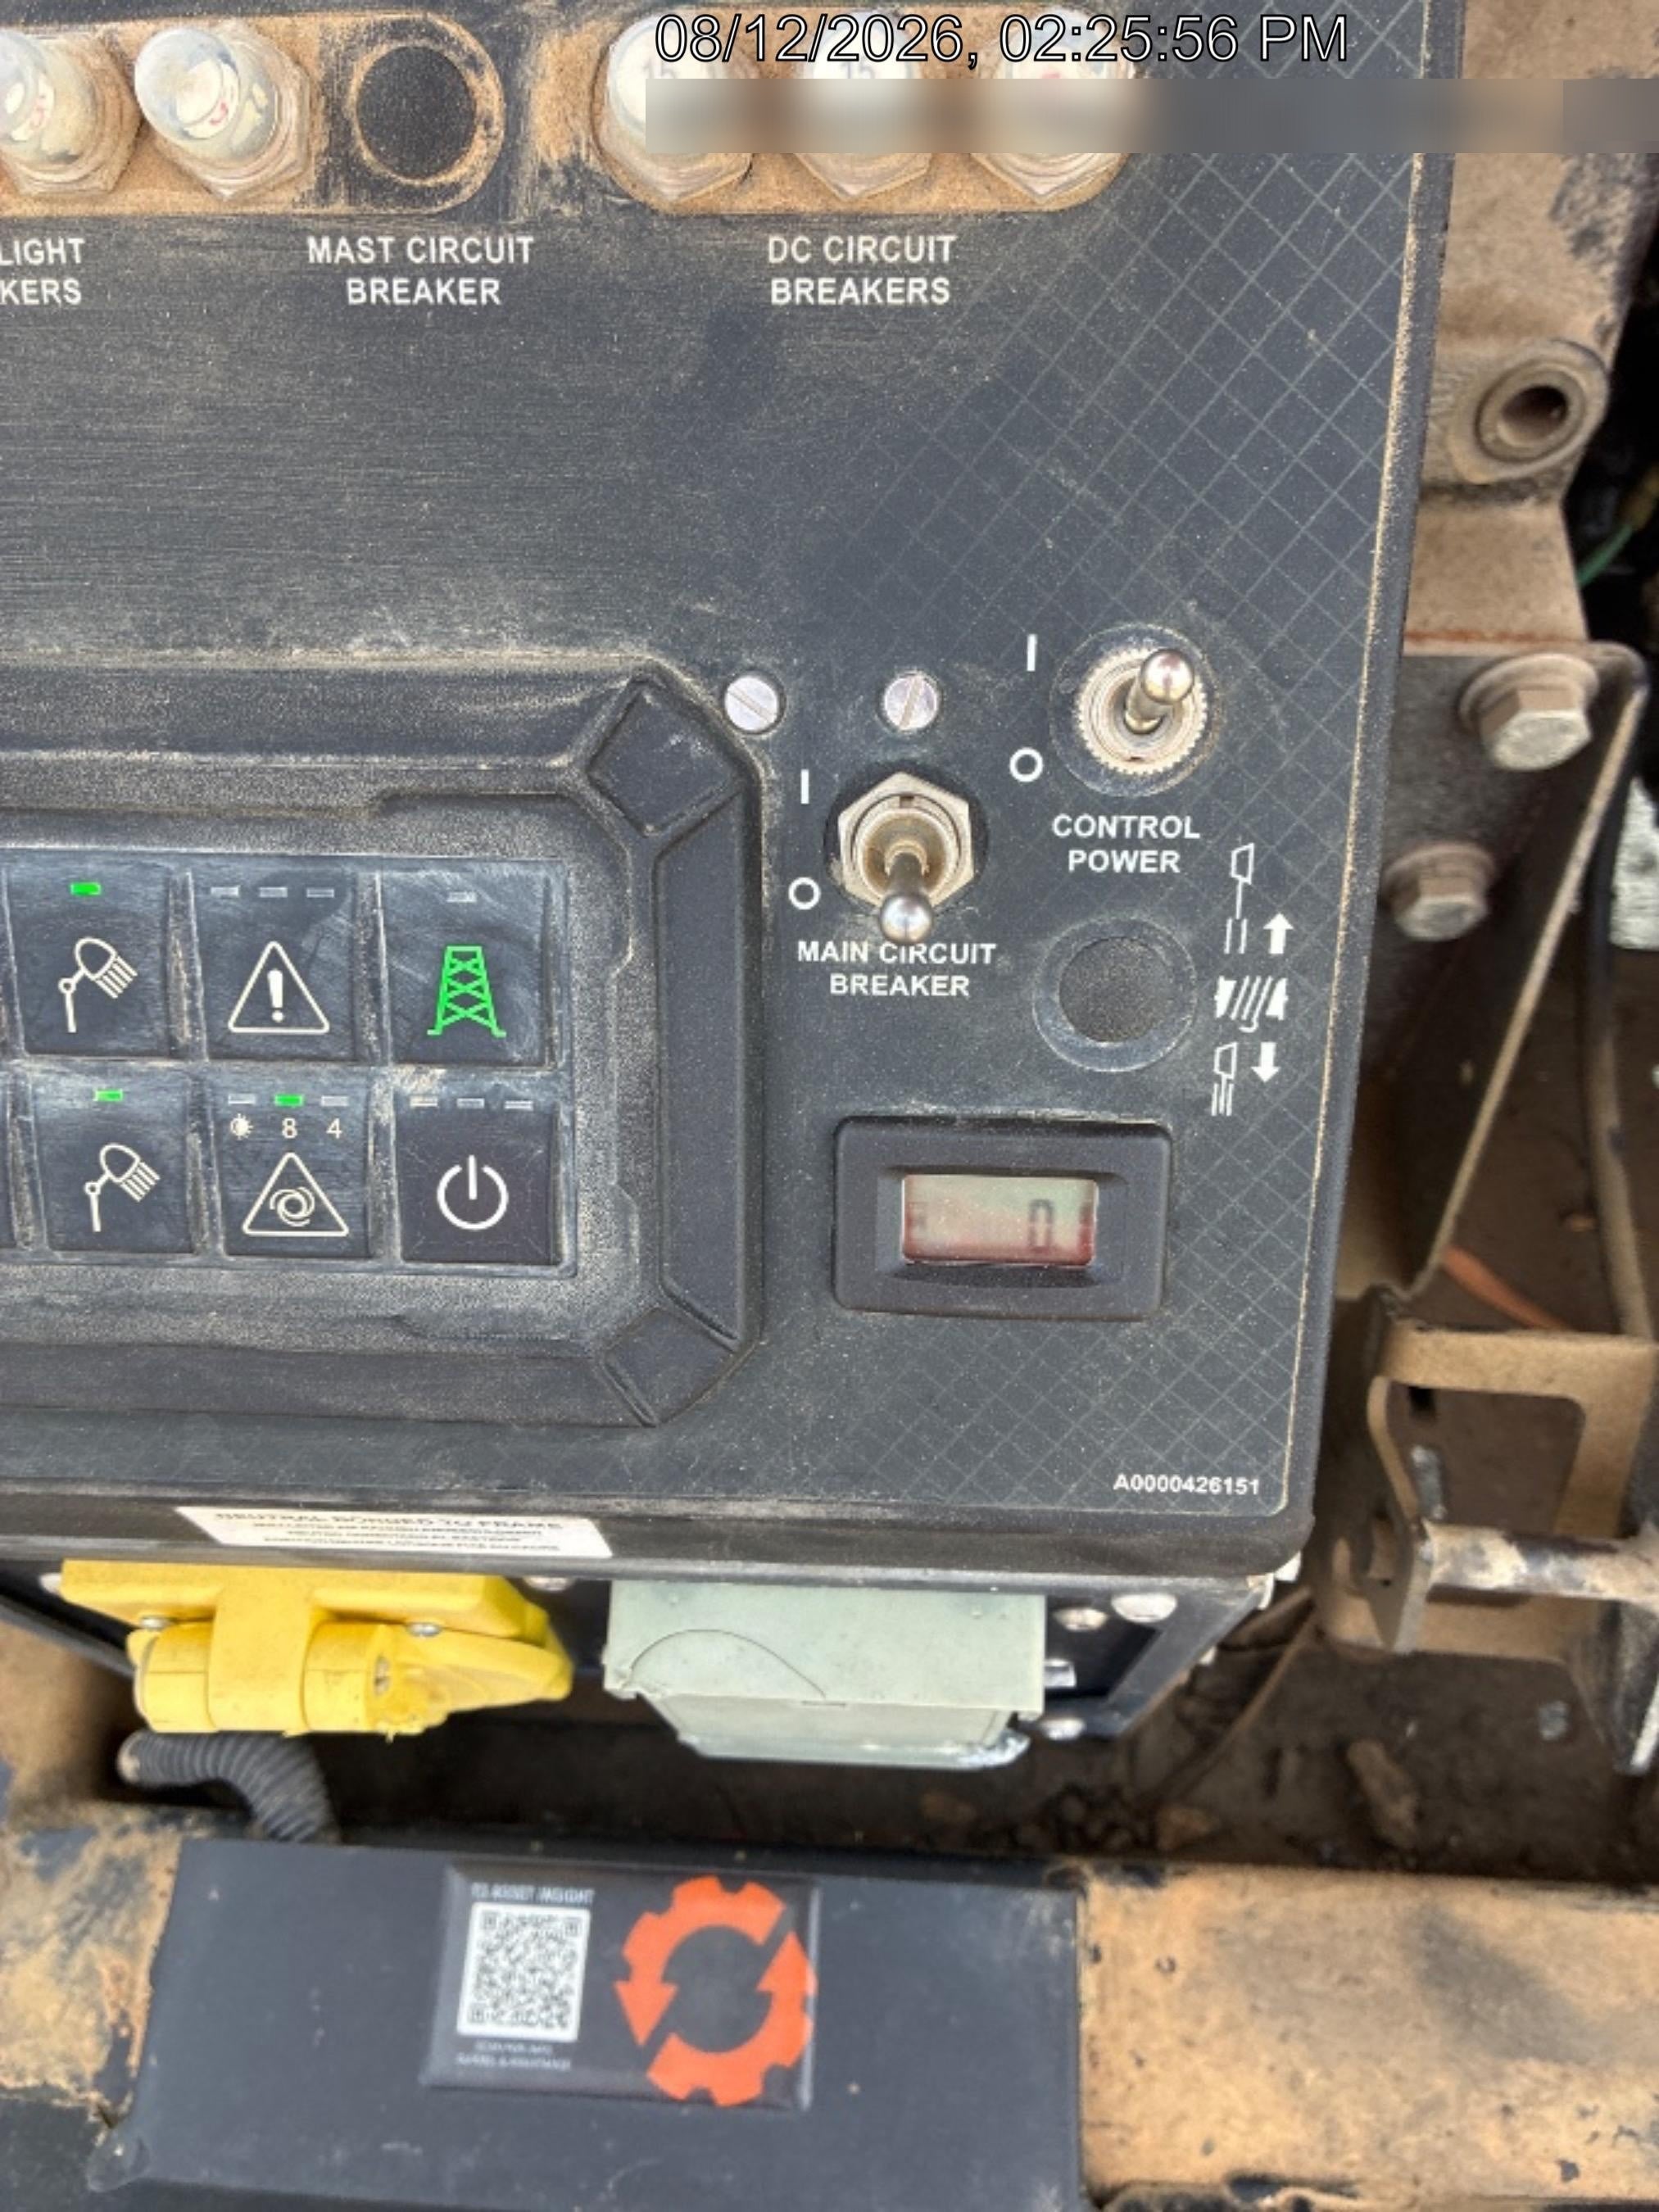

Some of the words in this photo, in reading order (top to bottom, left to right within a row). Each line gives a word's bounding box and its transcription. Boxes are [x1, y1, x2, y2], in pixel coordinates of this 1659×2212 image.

[0, 237, 85, 265] LIGHT
[307, 236, 396, 264] MAST
[406, 235, 534, 264] CIRCUIT
[768, 235, 813, 264] DC
[823, 235, 957, 264] CIRCUIT
[347, 277, 501, 306] BREAKER
[771, 277, 950, 306] BREAKERS
[1052, 814, 1200, 839] CONTROL
[1068, 850, 1181, 873] POWER
[797, 940, 869, 963] MAIN
[878, 942, 997, 964] CIRCUIT
[830, 973, 970, 997] BREAKER
[281, 1117, 298, 1139] 8
[326, 1117, 342, 1139] 4
[1113, 1473, 1259, 1495] A0000426151
